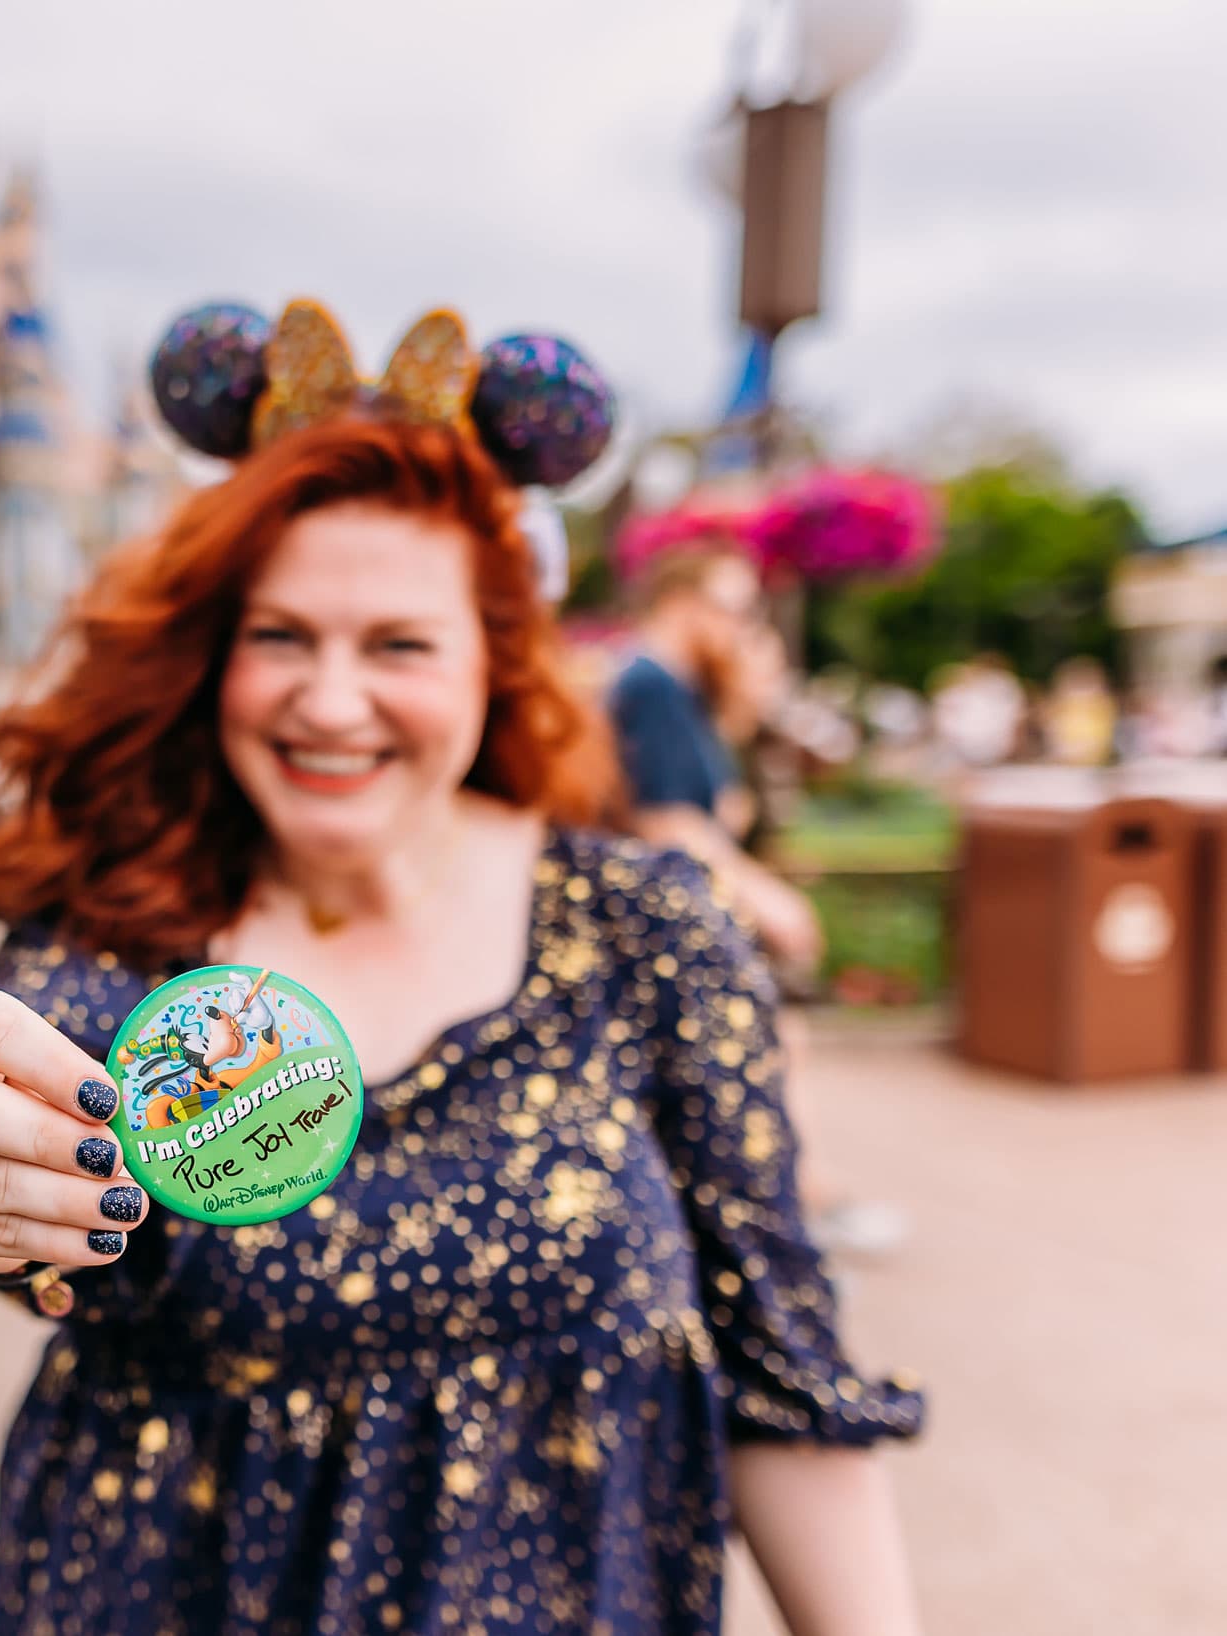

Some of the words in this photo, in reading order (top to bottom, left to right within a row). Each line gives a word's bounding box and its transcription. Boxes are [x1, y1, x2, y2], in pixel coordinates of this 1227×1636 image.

[137, 1138, 184, 1163] I'm
[185, 1055, 344, 1149] Celebrating:
[172, 1155, 245, 1194] Pure
[241, 1122, 293, 1161] Joy
[289, 1079, 353, 1133] Travel
